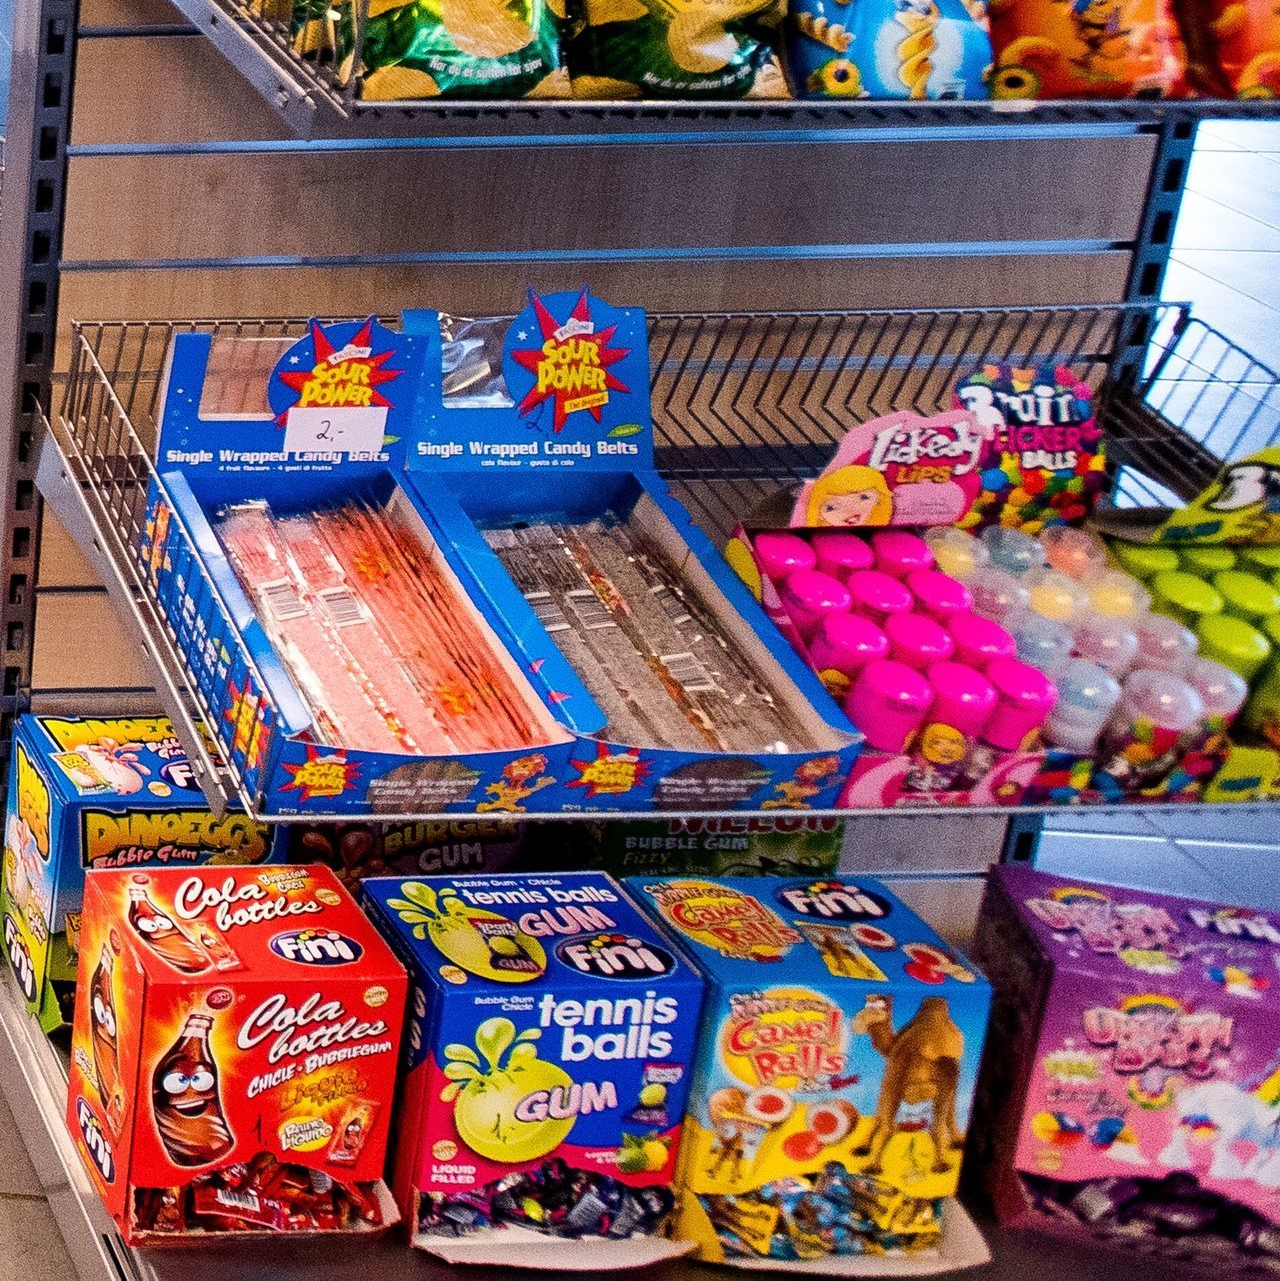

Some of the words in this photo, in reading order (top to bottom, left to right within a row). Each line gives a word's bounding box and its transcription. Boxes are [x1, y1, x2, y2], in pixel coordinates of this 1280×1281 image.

[541, 338, 601, 365] SOUR
[311, 361, 372, 385] SOUR
[537, 361, 607, 394] POWER
[299, 380, 374, 408] POWER
[166, 449, 214, 465] Single
[219, 450, 290, 467] Wrapped
[294, 452, 343, 467] Candy
[417, 441, 464, 458] Single
[469, 441, 539, 458] Wrapped
[544, 441, 591, 458] Candy
[597, 441, 639, 455] Belts
[419, 841, 484, 872] GUM
[174, 876, 267, 920] Cola
[452, 879, 489, 888] Bubble
[490, 879, 518, 887] Gum
[462, 888, 549, 906] tennis
[552, 886, 619, 904] balls
[216, 896, 322, 932] bottles
[781, 887, 885, 918] Fini
[518, 905, 619, 938] GUM
[277, 933, 355, 962] Fini
[564, 938, 666, 975] Fini
[474, 996, 509, 1005] Bubble
[510, 996, 535, 1004] Gum
[538, 990, 679, 1028] tennis
[237, 992, 345, 1050] Cola
[268, 1017, 389, 1064] bottles
[561, 1025, 674, 1062] balls
[247, 1062, 297, 1099] CHICLE
[515, 1080, 619, 1123] GUM
